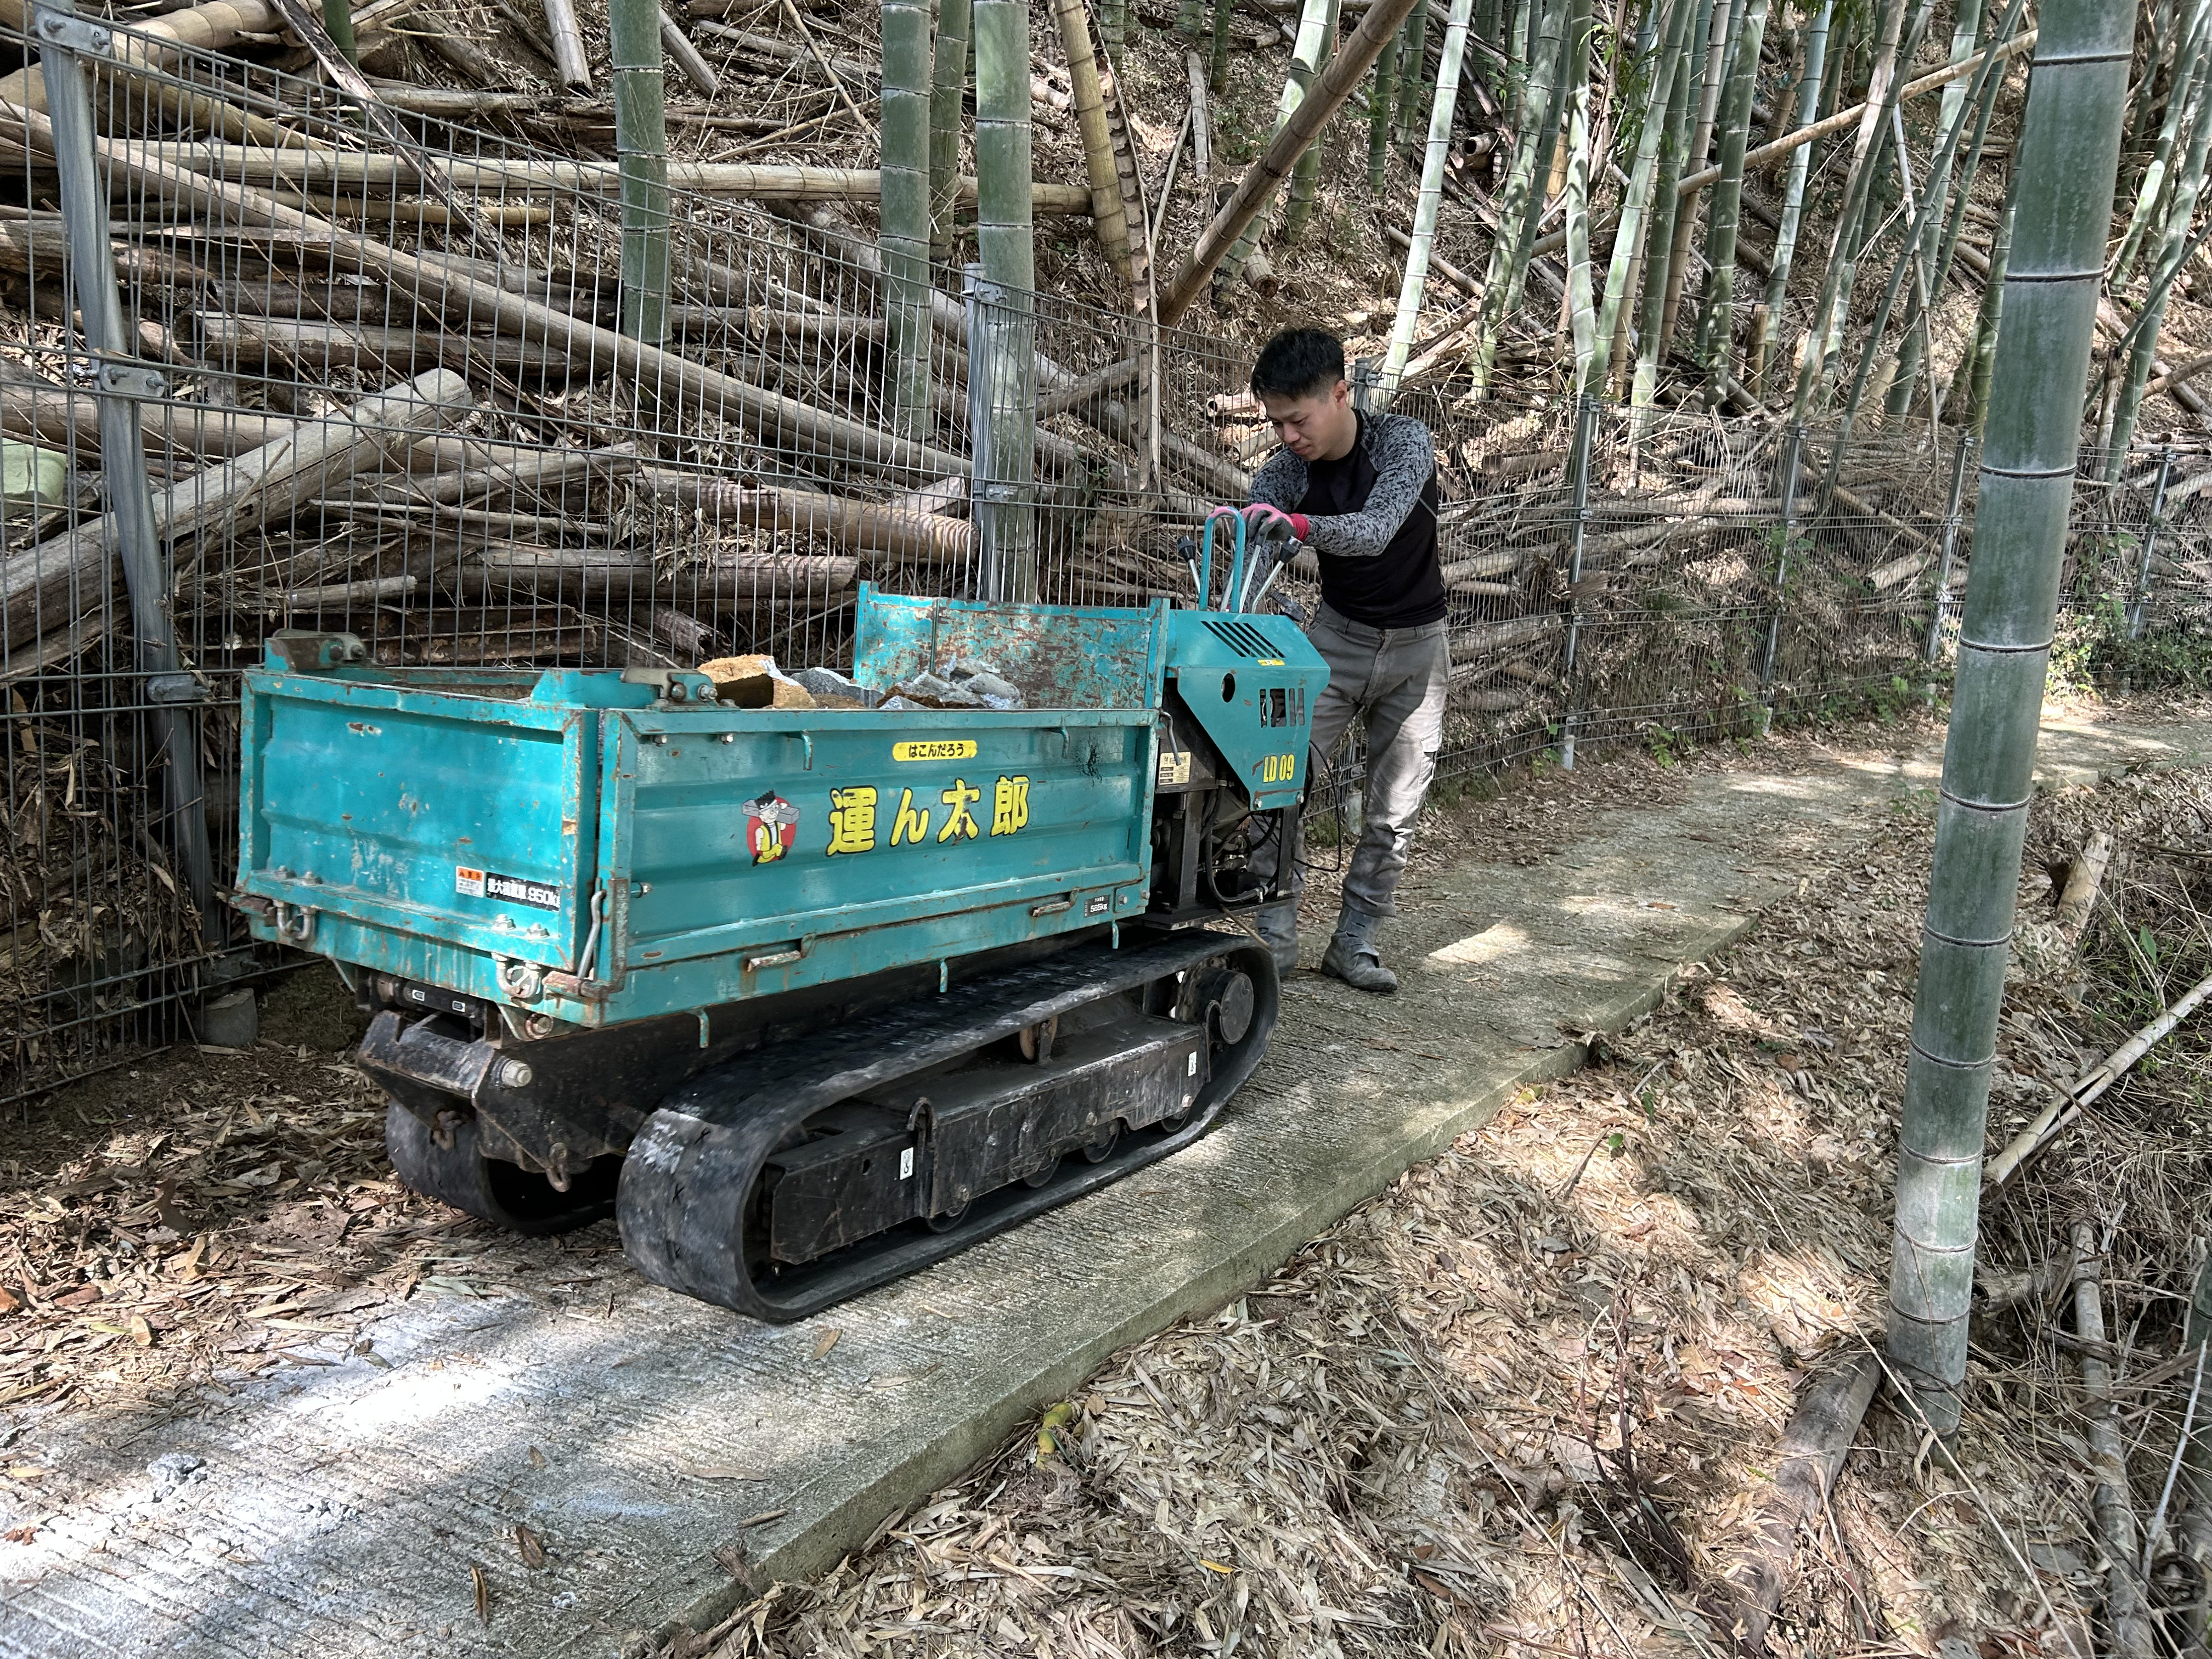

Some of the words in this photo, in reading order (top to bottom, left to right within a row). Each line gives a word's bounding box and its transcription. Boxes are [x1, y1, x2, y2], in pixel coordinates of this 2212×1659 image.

[909, 743, 964, 758] はこんだろう
[1263, 755, 1277, 783] LD
[1279, 754, 1295, 781] 09
[826, 774, 1030, 857] 運ん太郎
